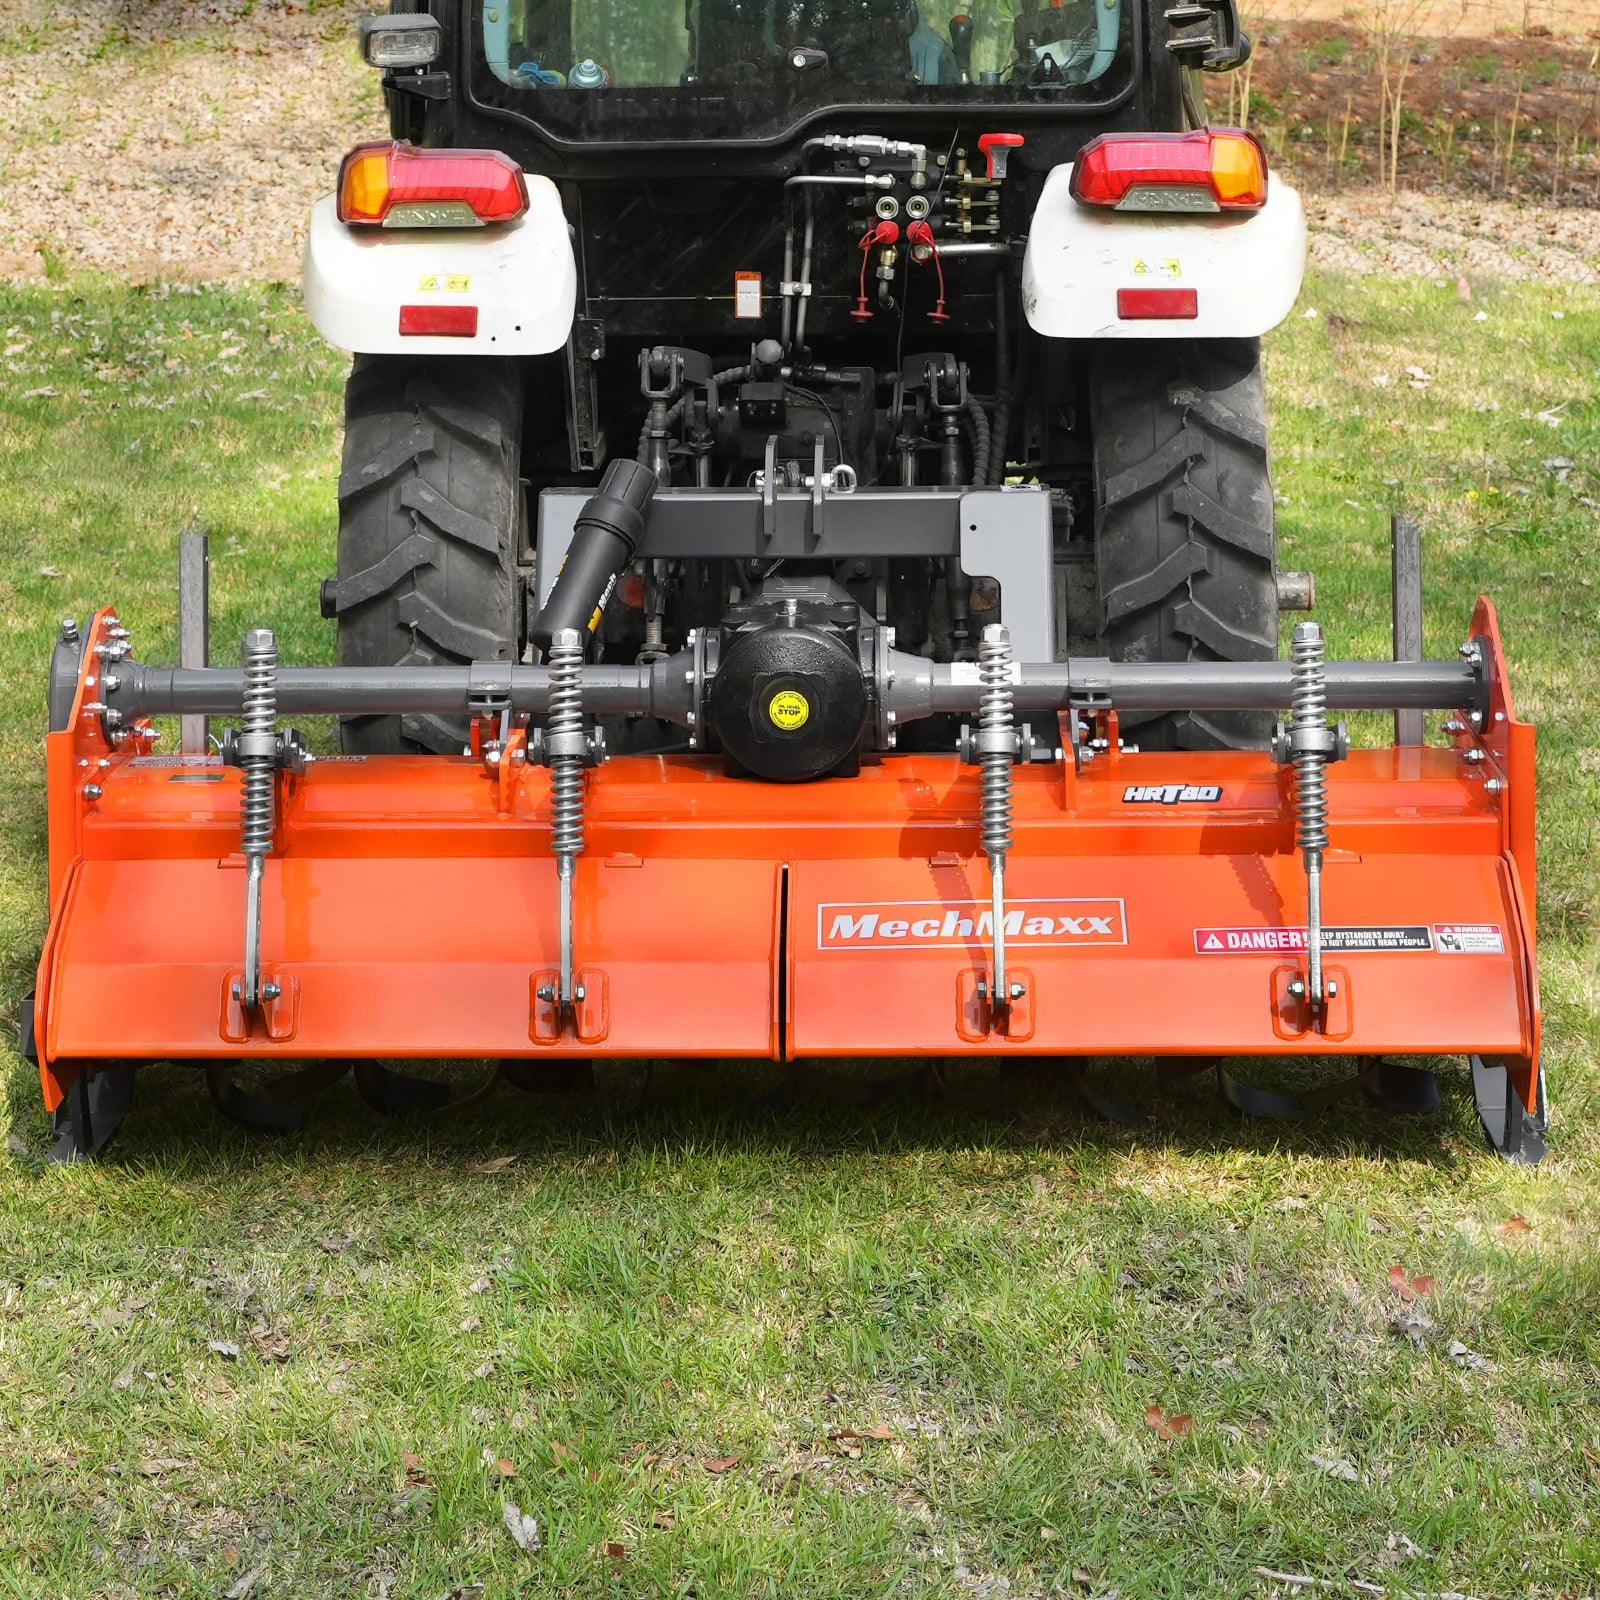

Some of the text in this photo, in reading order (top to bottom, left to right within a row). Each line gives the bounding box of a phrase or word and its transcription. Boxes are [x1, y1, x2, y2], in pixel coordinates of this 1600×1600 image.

[828, 910, 1115, 939] MechMaxx
[1226, 931, 1309, 949] DANGER!
[1318, 931, 1408, 940] EEP BYSTANDERS AWAY.
[1329, 939, 1343, 947] NOT
[1345, 939, 1377, 947] OPERATE
[1399, 938, 1429, 946] PEOPLE.
